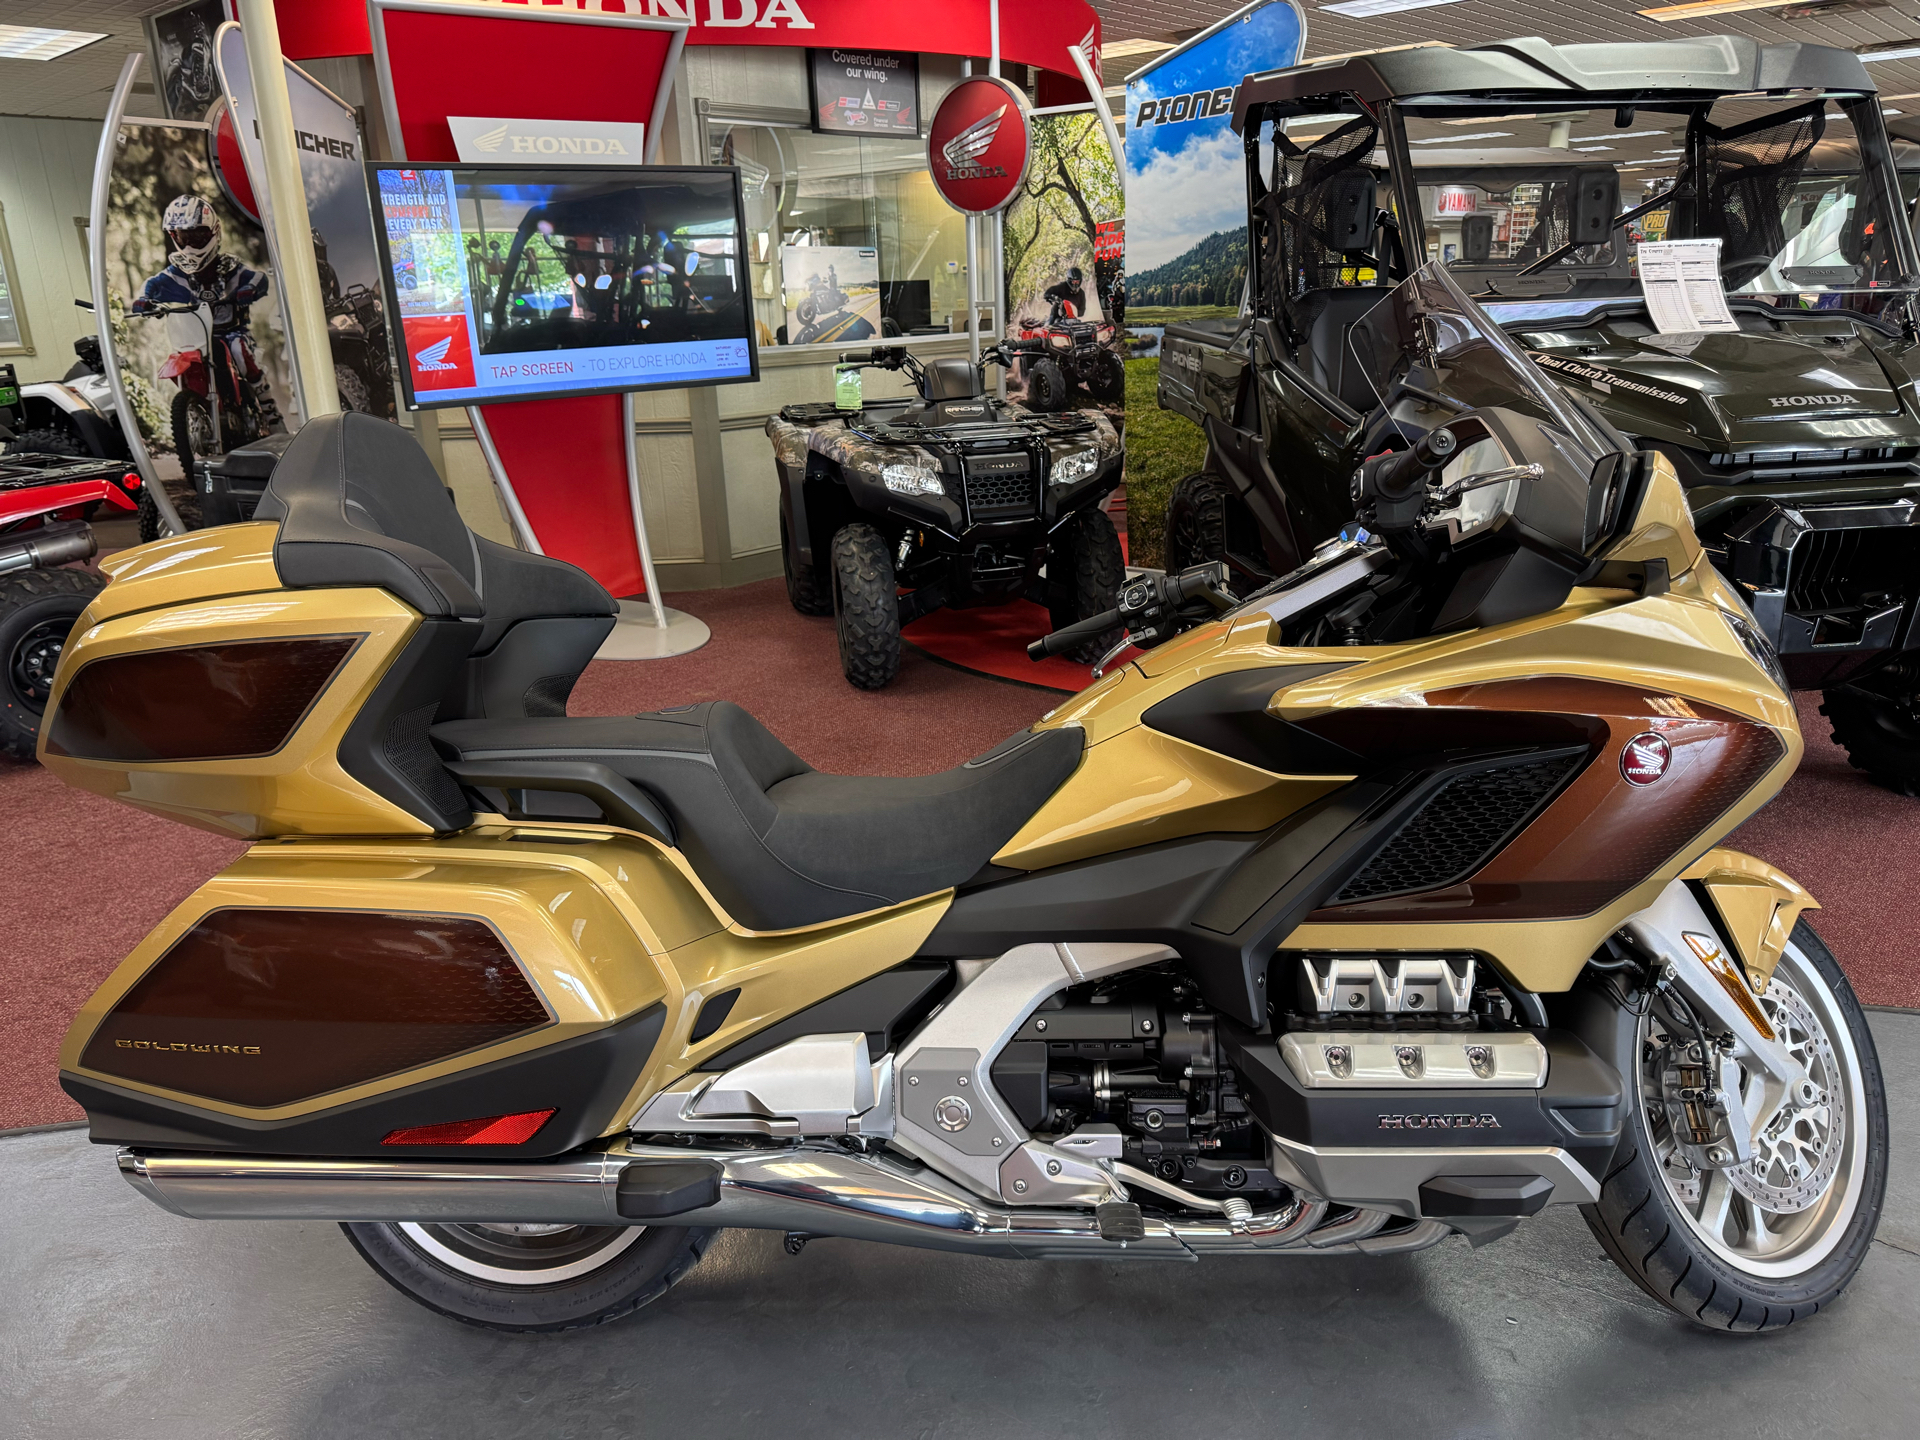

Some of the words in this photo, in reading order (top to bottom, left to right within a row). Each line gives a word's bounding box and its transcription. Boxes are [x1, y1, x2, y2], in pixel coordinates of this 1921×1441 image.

[832, 49, 872, 66] Covered
[873, 55, 900, 69] under
[846, 67, 862, 78] our
[863, 67, 888, 84] wing.
[510, 135, 629, 155] HONDA
[946, 165, 1008, 181] HONDA
[381, 194, 424, 206] TRENGTH
[427, 194, 446, 206] AND
[1447, 193, 1477, 212] YAMAHA
[384, 205, 429, 218] COMFORT
[431, 205, 443, 217] IN
[388, 218, 417, 231] EVERY
[419, 218, 444, 230] TASK
[1095, 221, 1115, 235] WE
[1645, 214, 1667, 228] PRO
[1094, 231, 1125, 249] RIDE
[1094, 246, 1122, 263] FUN
[417, 363, 458, 372] HONDA
[490, 365, 518, 379] TAP
[521, 361, 574, 376] SCREEN
[588, 358, 606, 372] TO
[609, 354, 663, 371] EXPLORE
[665, 352, 708, 367] HONDA
[1535, 354, 1567, 369] Dual
[1563, 363, 1603, 380] Clutch
[1601, 373, 1689, 405] Transmission
[1767, 394, 1861, 407] HONDA
[974, 460, 1026, 471] HONDA
[1627, 767, 1662, 775] HONDA
[114, 1039, 262, 1055] GOLDWING
[1377, 1113, 1502, 1129] HONDA
